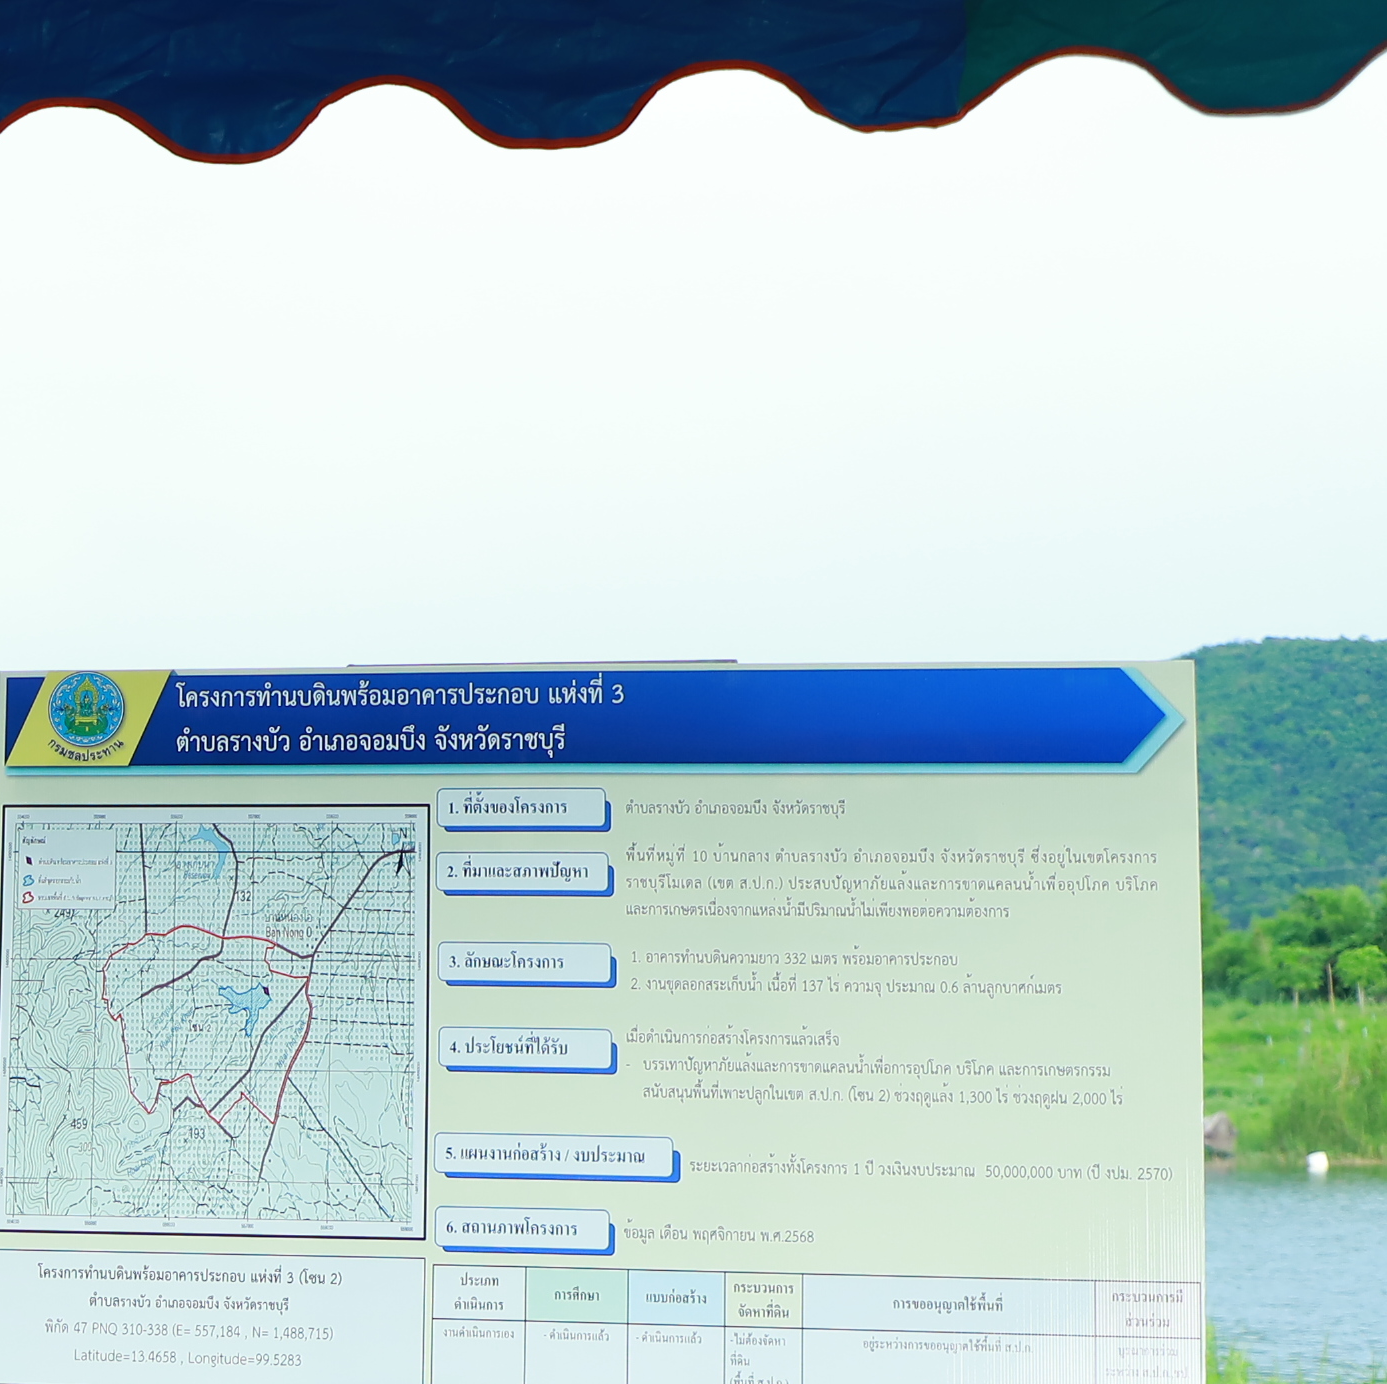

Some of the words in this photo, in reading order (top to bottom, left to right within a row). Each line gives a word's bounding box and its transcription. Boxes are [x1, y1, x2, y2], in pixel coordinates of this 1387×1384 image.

[175, 679, 539, 708] โครงการทำนบดินพร้อมอาคารประกอบ
[548, 672, 603, 704] แห่งที่
[611, 684, 624, 704] 3
[47, 737, 126, 763] กรมชลประทาน
[176, 725, 290, 752] ตำบลรางบัว
[299, 724, 425, 752] อำเภอจอมบึง
[434, 723, 566, 759] จังหวัดราชบุรี
[463, 791, 567, 814] ที่ตั้งของโครงการ
[625, 798, 690, 815] ตำบลรางบัว
[694, 798, 767, 815] อำเภอจอมบึง
[772, 799, 845, 820] จังหวัดราชบุรี
[692, 850, 708, 863] 10
[712, 842, 770, 863] บ้านกลาง
[775, 847, 848, 863] ตำบลรางบัว
[853, 846, 935, 864] อำเภอจอมบึง
[940, 847, 1025, 869] จังหวัดราชบุรี
[707, 875, 734, 891] (เขต
[739, 875, 783, 891] ส.ป.ก.)
[1115, 874, 1158, 892] บริโภค
[235, 890, 252, 903] 132
[465, 950, 564, 969] ลักษณะโครงการ
[645, 948, 780, 965] อาคารทำนบดินความยาว
[784, 952, 807, 965] 332
[810, 954, 838, 965] เมตร
[842, 944, 958, 966] พร้อมอาคารประกอบ
[767, 971, 797, 992] เนื้อที่
[802, 979, 824, 993] 137
[826, 973, 840, 993] ไร่
[844, 981, 882, 998] ความจุ
[885, 978, 936, 994] ประมาณ
[940, 980, 959, 994] 0.6
[464, 1031, 568, 1055] ประโยชน์ที่ได้รับ
[956, 1058, 995, 1076] บริโภค
[999, 1065, 1111, 1077] และการเกษตรกรรม
[808, 1086, 844, 1102] ส.ป.ก.
[848, 1085, 874, 1103] (โซน
[878, 1088, 891, 1103] 2)
[959, 1090, 993, 1105] 1,300
[995, 1084, 1008, 1104] ไร่
[1072, 1091, 1107, 1107] 2,000
[1109, 1085, 1123, 1106] ไร่
[71, 1118, 88, 1130] 459
[188, 1128, 205, 1140] 193
[460, 1142, 561, 1162] แผนงานก่อสร้าง
[573, 1144, 645, 1164] งบประมาณ
[864, 1159, 874, 1176] ปี
[878, 1160, 975, 1178] วงเงินงบประมาณ
[985, 1164, 1054, 1181] 50,000,000
[1057, 1167, 1082, 1179] บาท
[1137, 1166, 1173, 1182] 2570)
[462, 1216, 577, 1236] สถานภาพโครงการ
[623, 1218, 655, 1245] ข้อมูล
[659, 1223, 688, 1241] เดือน
[692, 1225, 756, 1245] พฤศจิกายน
[760, 1230, 815, 1243] พ.ศ.2568
[37, 1262, 246, 1283] โครงการทำนบดินพร้อมอาคารประกอบ
[250, 1264, 282, 1284] แห่งที่
[299, 1268, 326, 1285] (โซน
[330, 1271, 343, 1286] 2)
[460, 1271, 499, 1287] ประเภท
[554, 1285, 600, 1301] การศึกษา
[646, 1288, 707, 1304] แบบก่อสร้าง
[733, 1283, 794, 1294] กระบวนการ
[89, 1291, 151, 1308] ตำบลรางบัว
[155, 1294, 220, 1310] อำเภอจอมบึง
[223, 1296, 289, 1316] จังหวัดราชบุรี
[454, 1296, 504, 1311] ดำเนินการ
[738, 1303, 789, 1319] จัดหาที่ดิน
[892, 1291, 1003, 1315] การขออนุญาตใช้พื้นที่
[44, 1318, 69, 1334] พิกัด
[73, 1321, 88, 1334] 47
[92, 1321, 118, 1336] PNQ
[122, 1322, 168, 1336] 310-338
[172, 1323, 191, 1338] (E=
[194, 1324, 241, 1339] 557,184
[252, 1326, 269, 1338] N=
[274, 1326, 334, 1342] 1,488,715)
[442, 1325, 515, 1339] งานดำเนินการเอง
[549, 1327, 610, 1342] ดำเนินการแล้ว
[641, 1330, 702, 1344] ดำเนินการแล้ว
[74, 1348, 177, 1364] Latitude=13.4658
[188, 1351, 302, 1368] Longitude=99.5283
[730, 1350, 750, 1366] ที่ดิน
